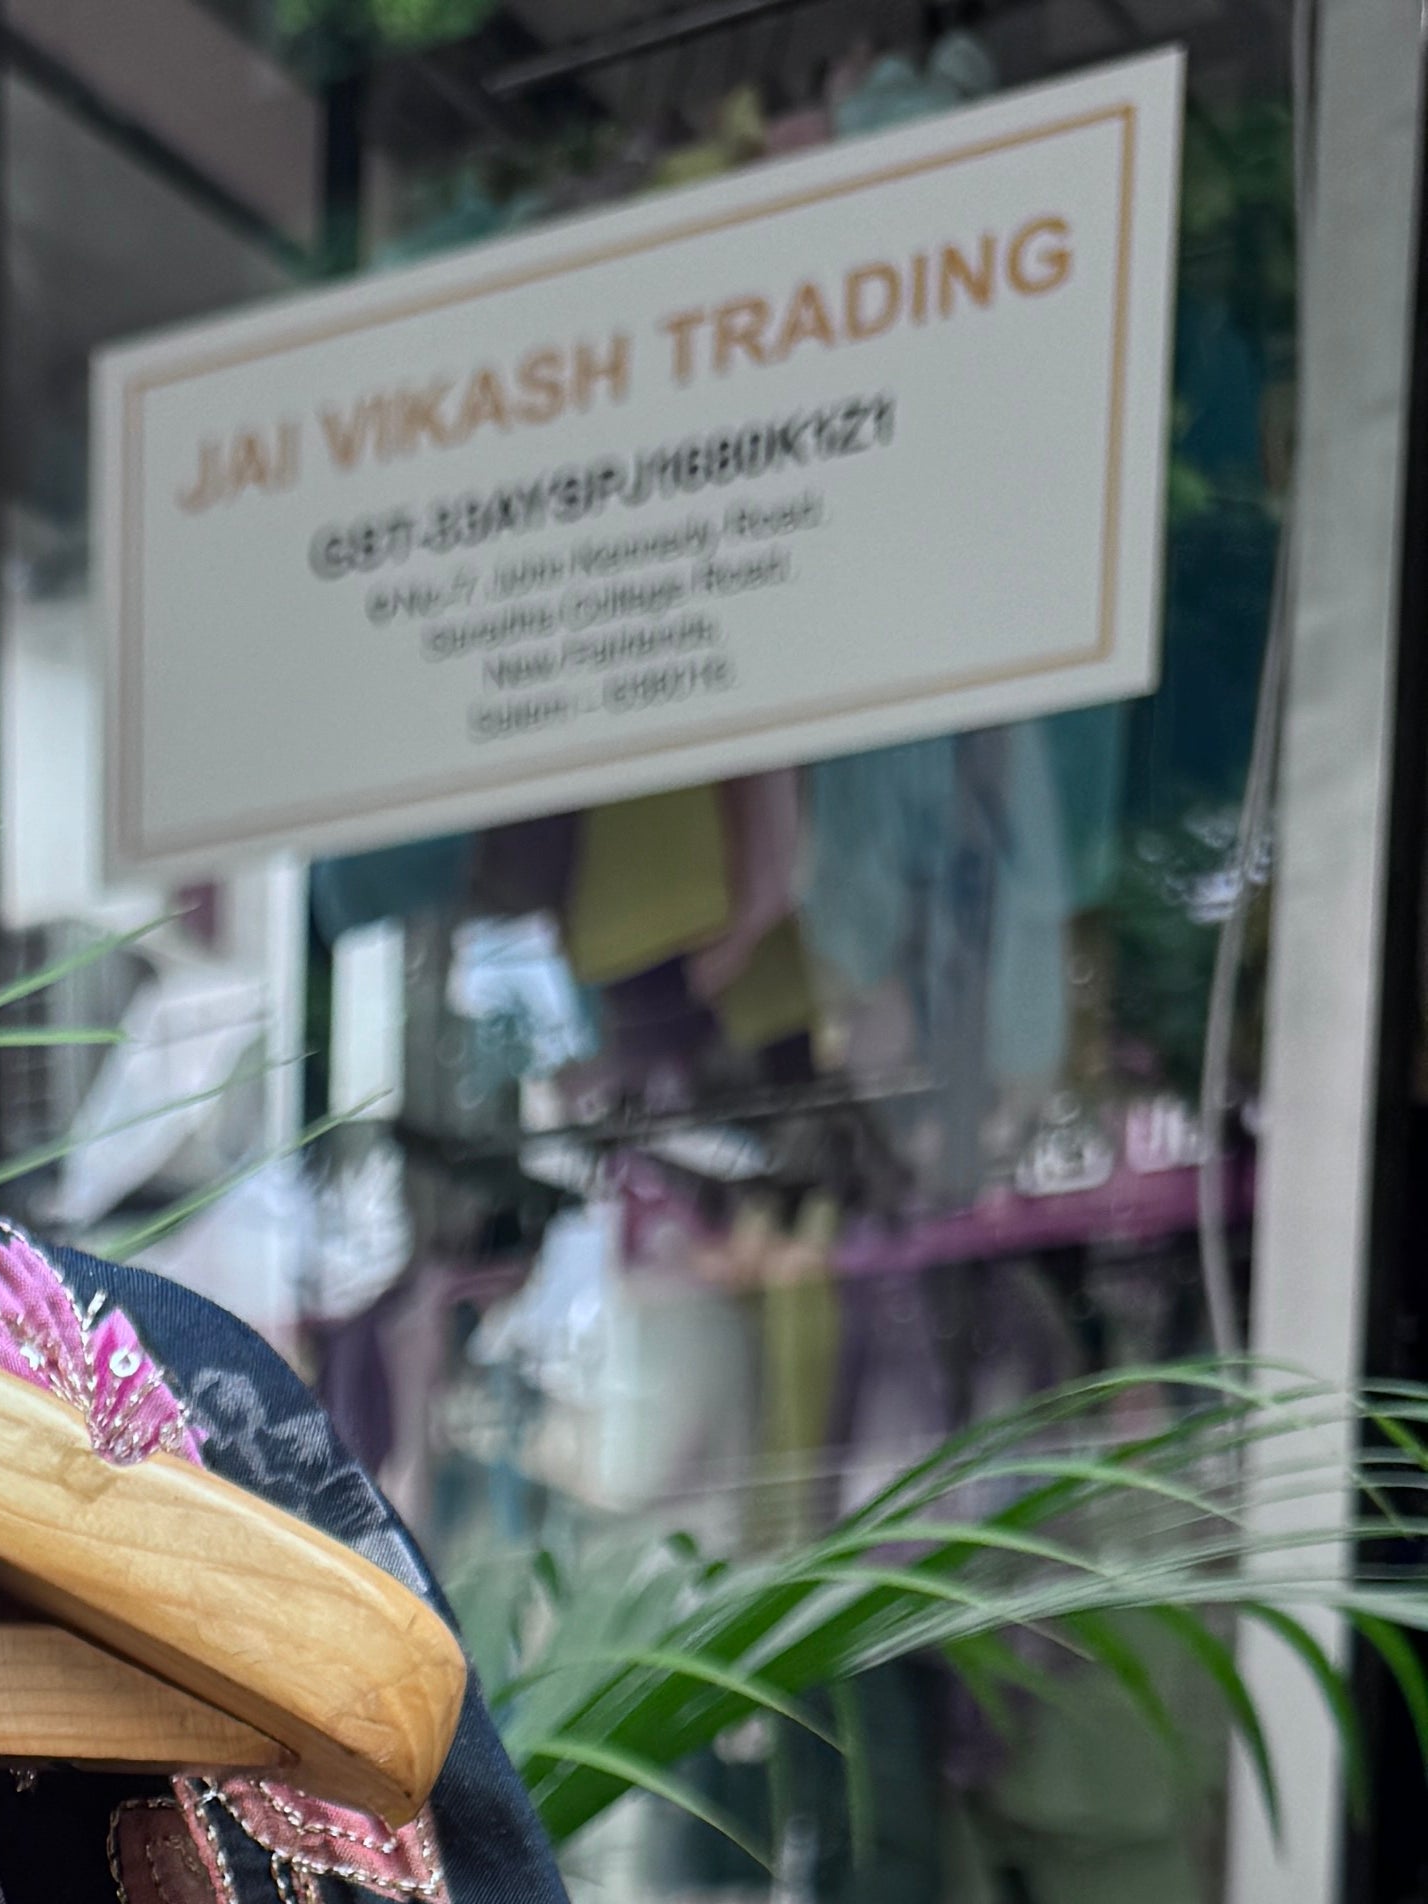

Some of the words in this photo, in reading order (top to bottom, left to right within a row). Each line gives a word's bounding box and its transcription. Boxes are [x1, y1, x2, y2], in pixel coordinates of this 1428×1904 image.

[176, 414, 300, 515] JAI
[312, 332, 631, 476] VIKASH
[660, 215, 1073, 392] TRADING
